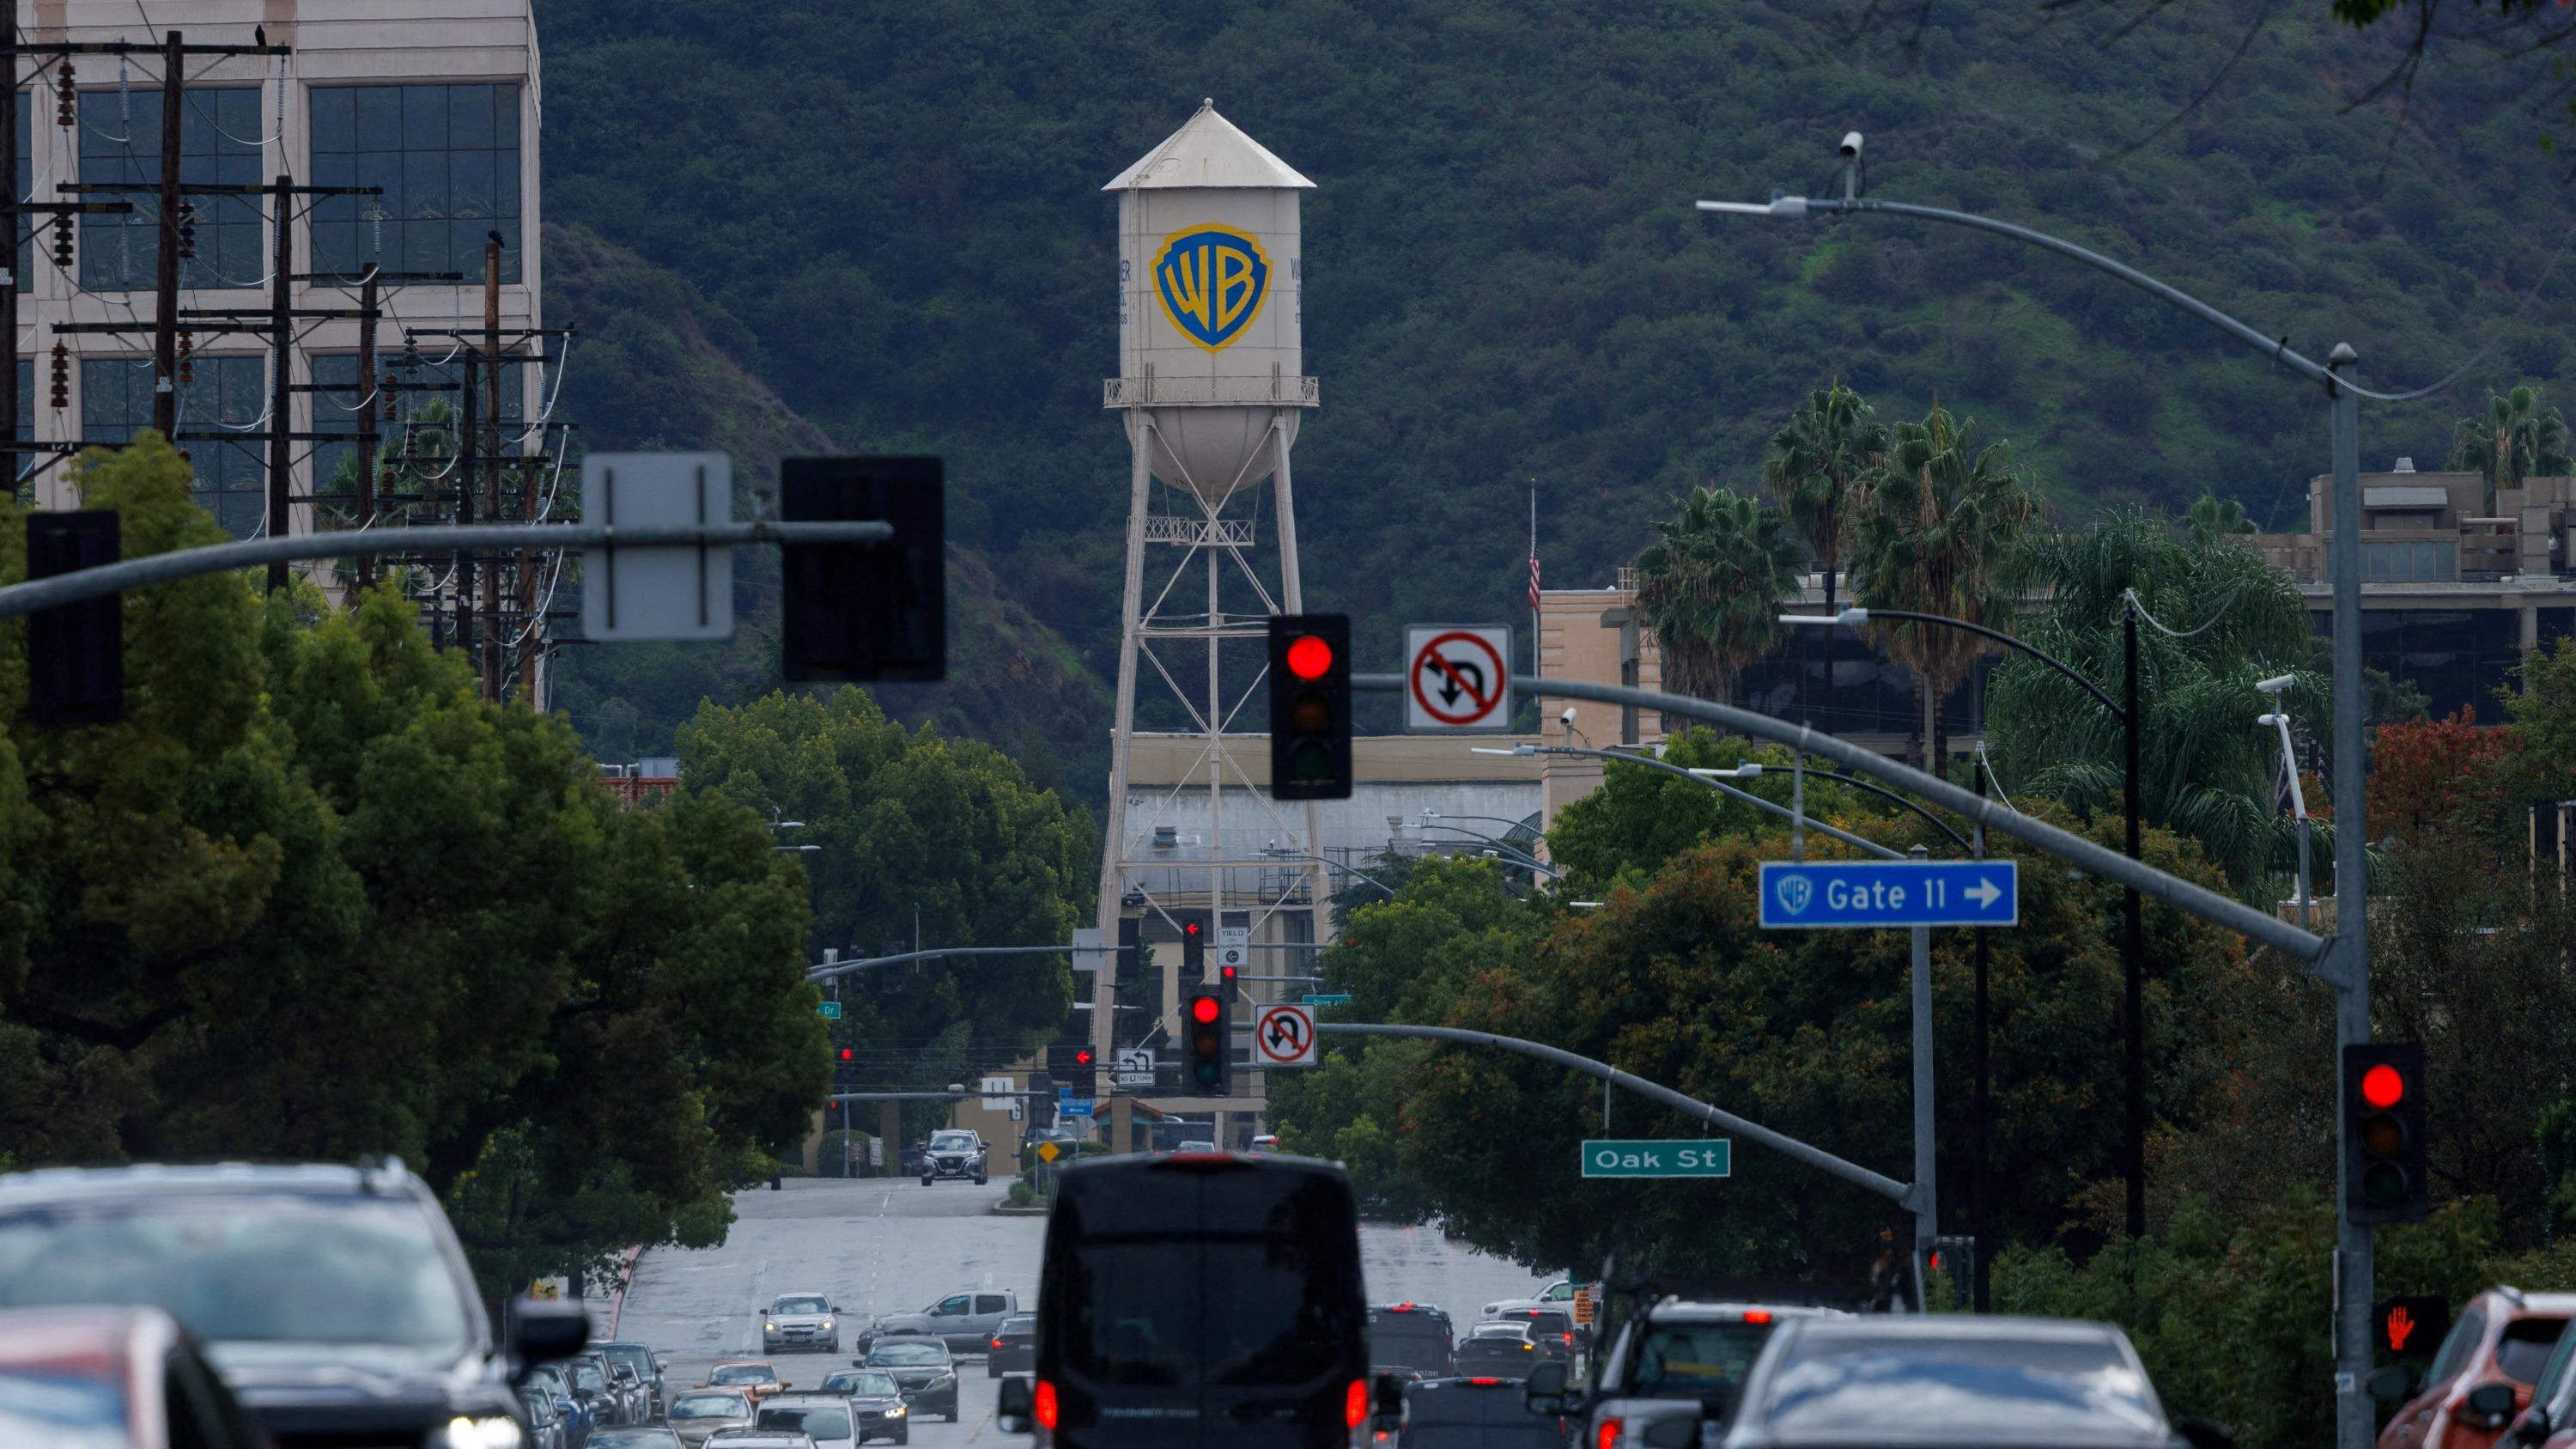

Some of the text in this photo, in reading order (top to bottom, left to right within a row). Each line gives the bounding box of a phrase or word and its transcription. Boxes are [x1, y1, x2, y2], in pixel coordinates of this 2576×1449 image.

[1164, 245, 1255, 333] WB
[1827, 879, 1905, 910] Gate
[1924, 878, 1945, 909] 11
[824, 1006, 834, 1015] Dr
[1595, 1149, 1716, 1169] Oak St
